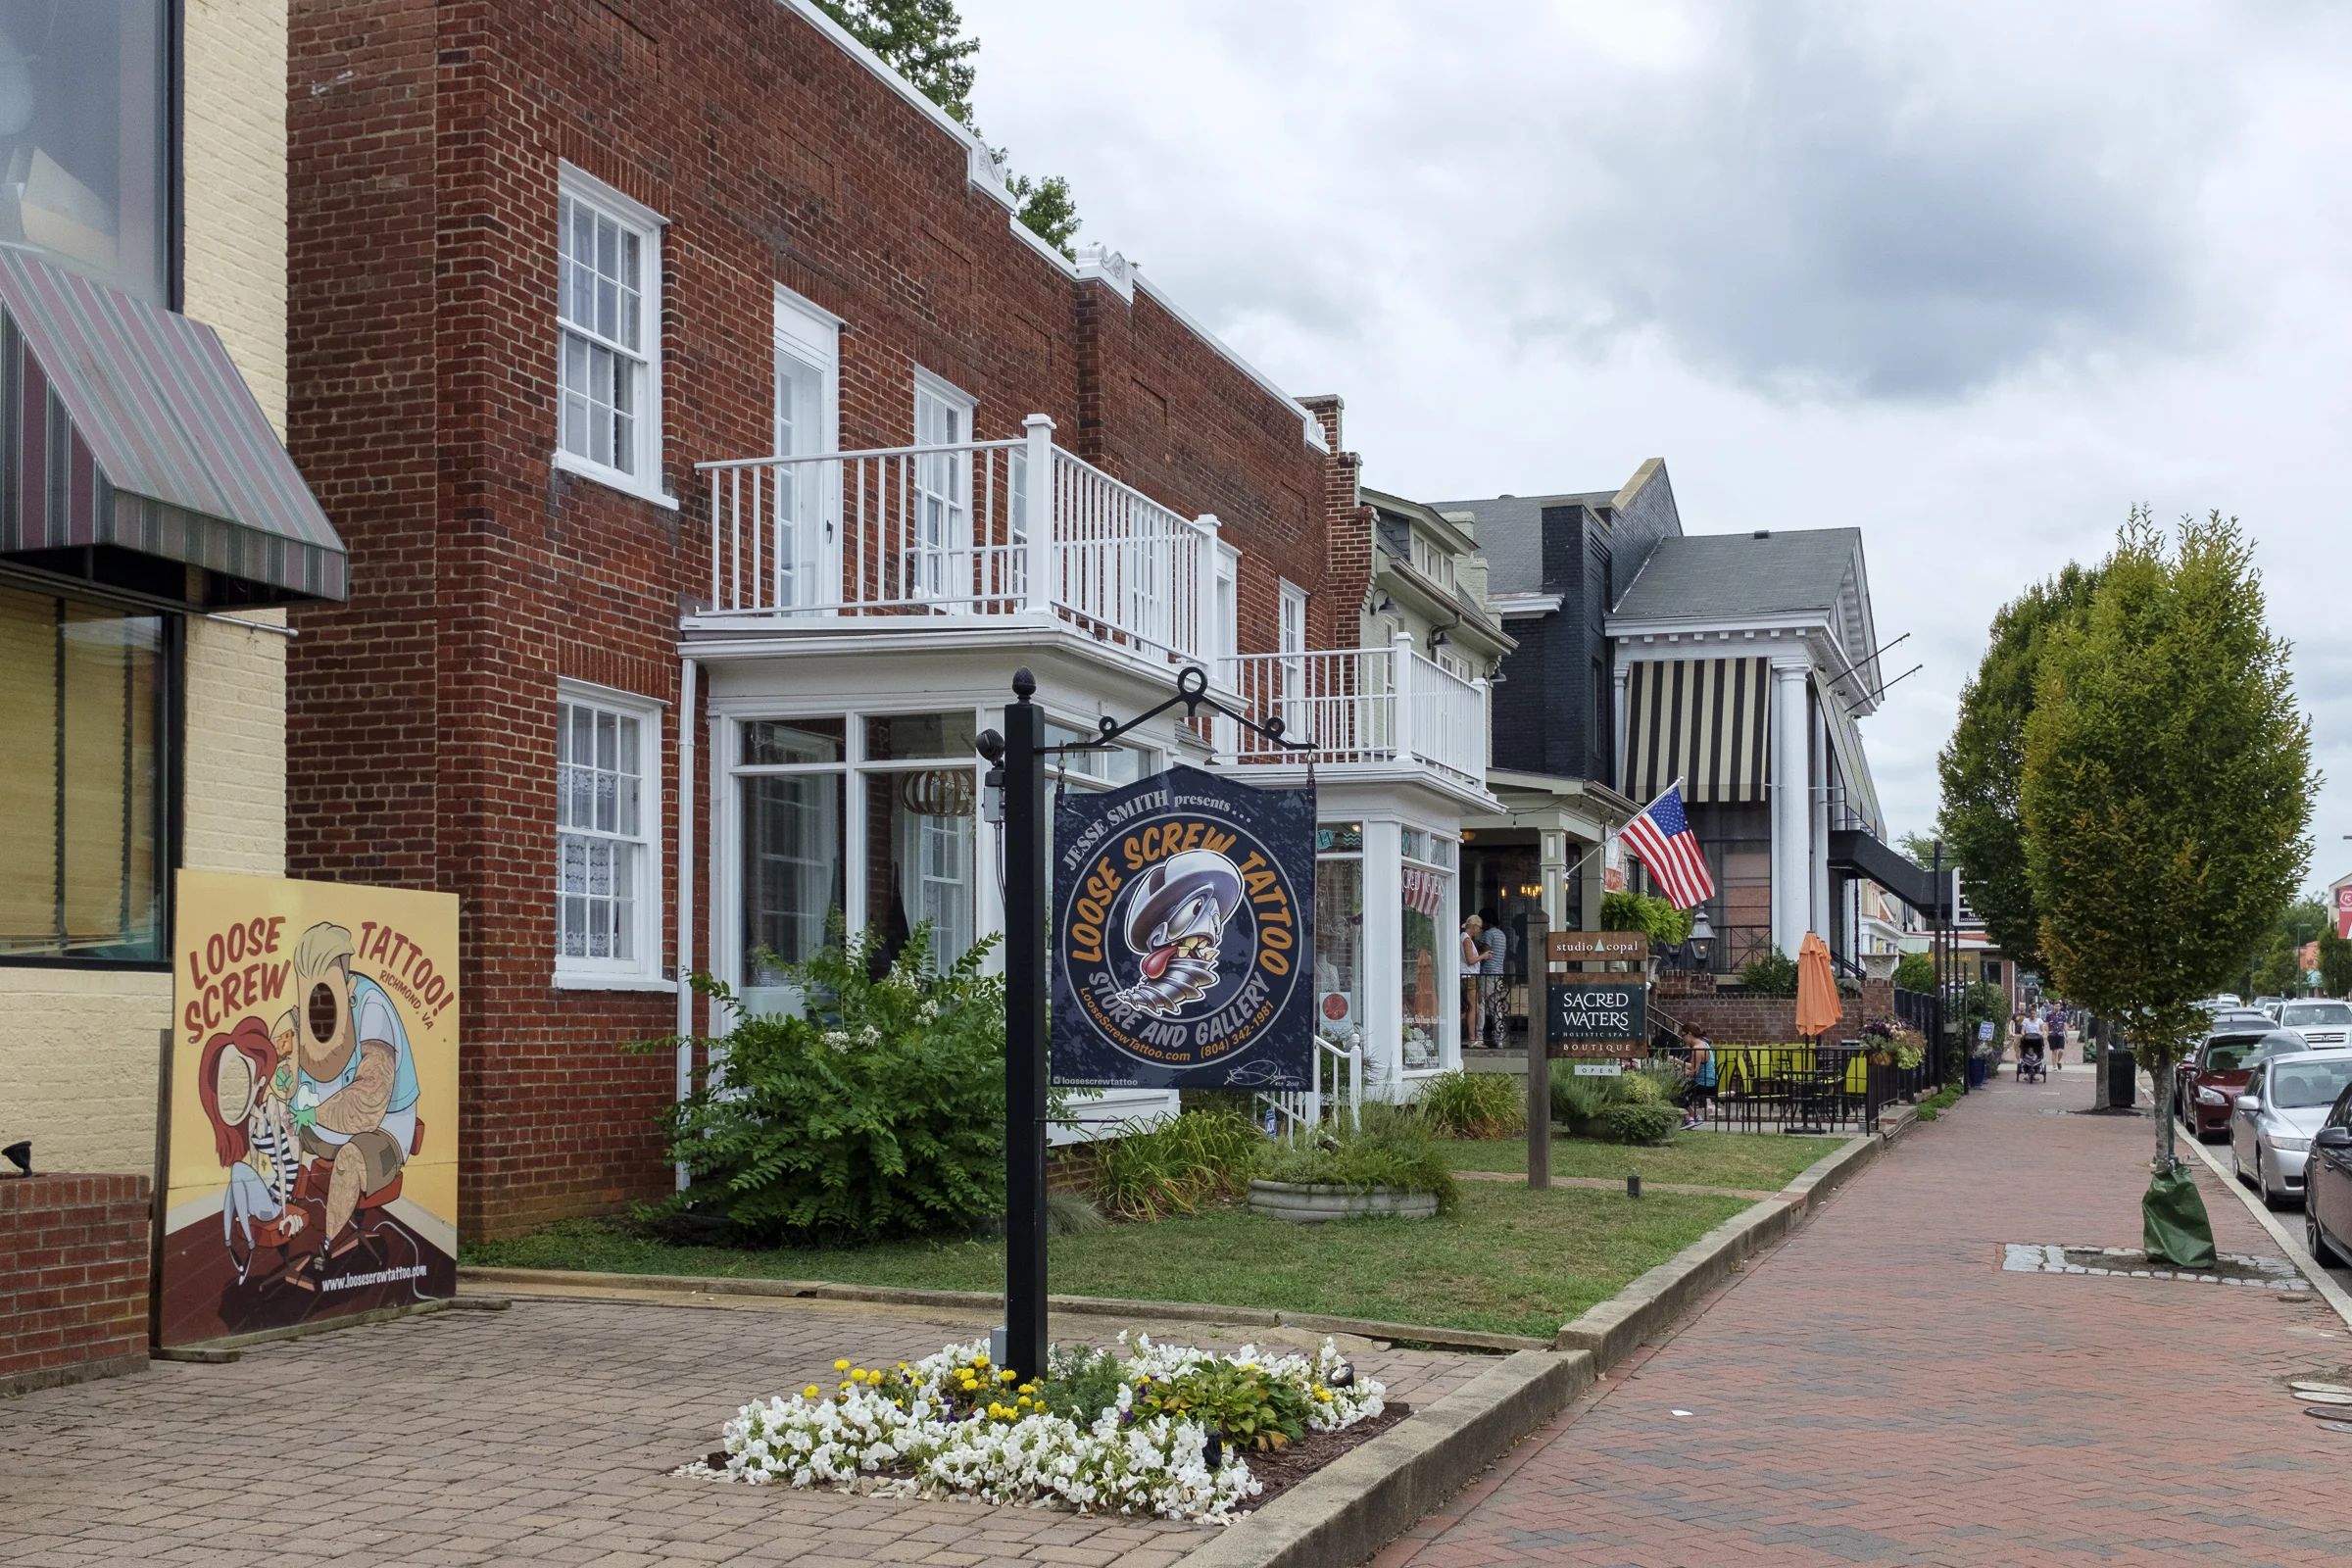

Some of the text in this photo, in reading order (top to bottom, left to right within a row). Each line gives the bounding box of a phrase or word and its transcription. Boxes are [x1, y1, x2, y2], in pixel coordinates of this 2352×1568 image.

[1062, 818, 1108, 871] JESSE
[1107, 789, 1170, 827] SMITH
[1072, 822, 1294, 975] LOOSE SCREW TATTOO
[189, 915, 286, 990] LOOSE
[359, 921, 455, 1016] TATTOO!
[1556, 940, 1638, 954] studio copal
[184, 958, 291, 1044] SCREW
[421, 1011, 434, 1031] VA
[1080, 987, 1275, 1061] LooseScrewTattoo.com (804) 342-1981
[1089, 972, 1271, 1048] STORE AND GALLERY
[1562, 1011, 1630, 1031] WATERS
[1563, 993, 1629, 1010] SACRED
[1563, 1044, 1631, 1053] BOUTIQUE
[1062, 1076, 1138, 1086] loosescrewtattoo
[321, 1265, 427, 1293] www.loosescrewtattoo.com
